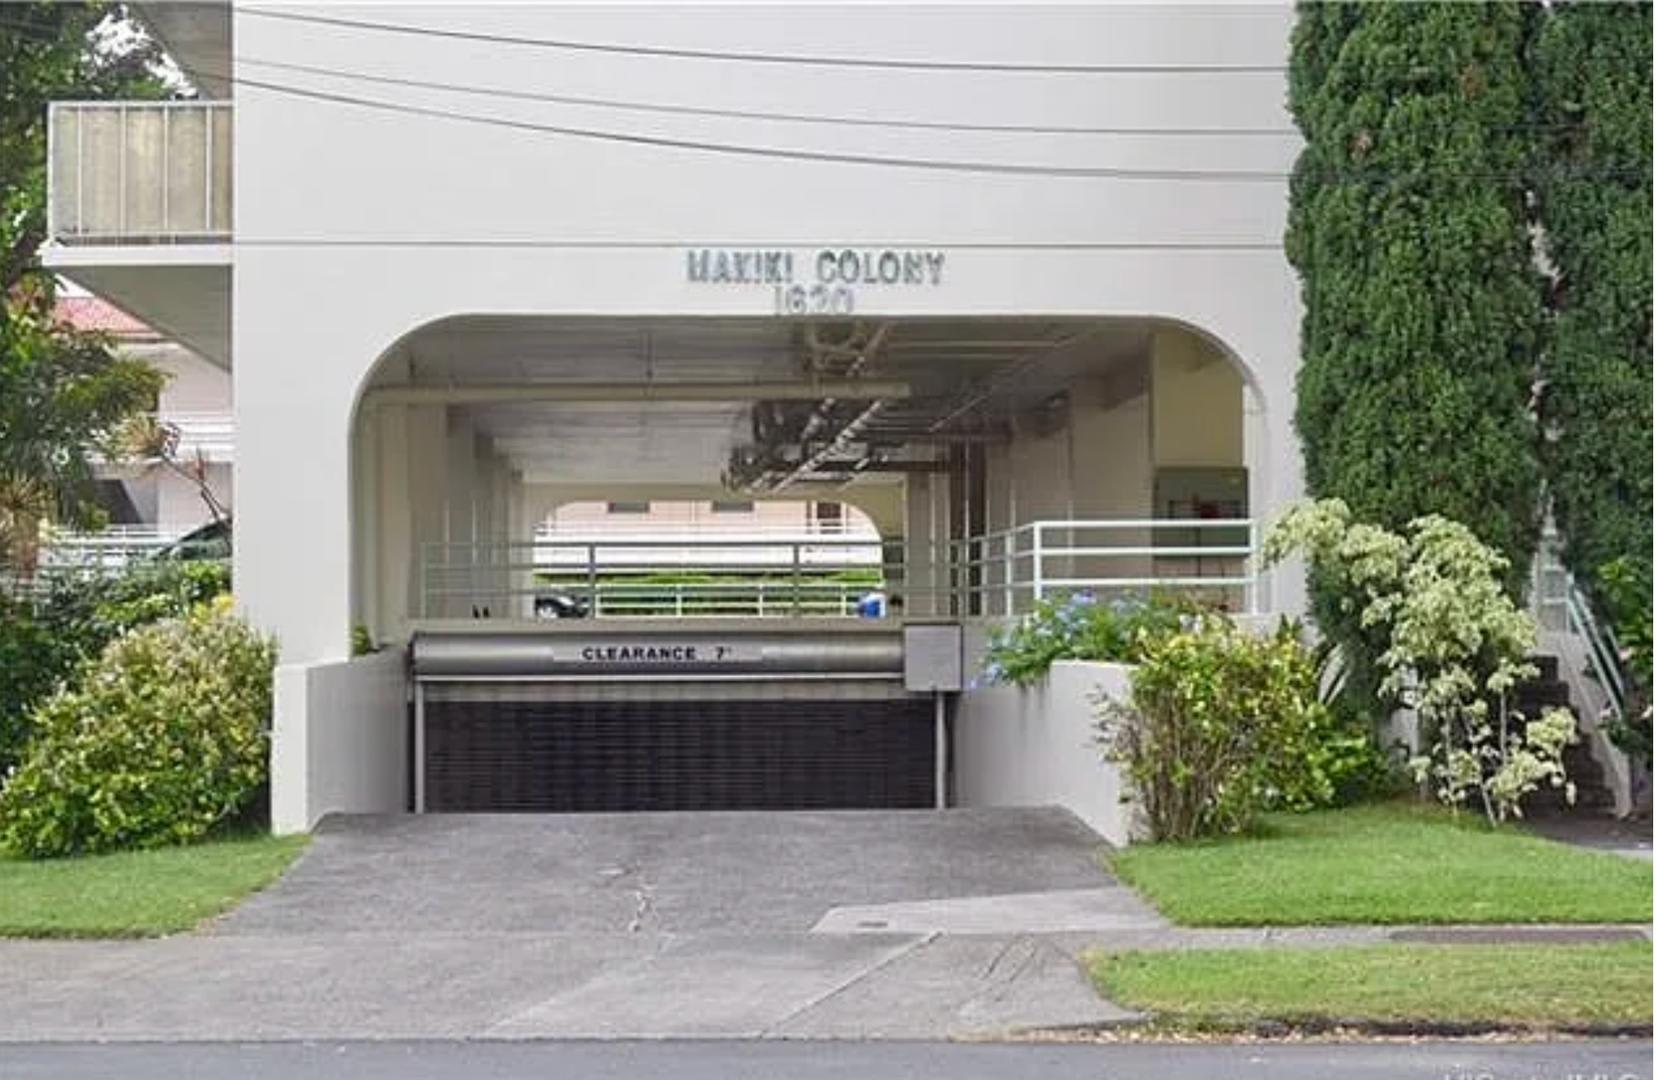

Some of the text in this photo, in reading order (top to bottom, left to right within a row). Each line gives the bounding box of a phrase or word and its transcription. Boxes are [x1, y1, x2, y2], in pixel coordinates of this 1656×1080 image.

[688, 249, 945, 286] MAKIKI COLONY
[582, 645, 697, 661] CLEARANCE
